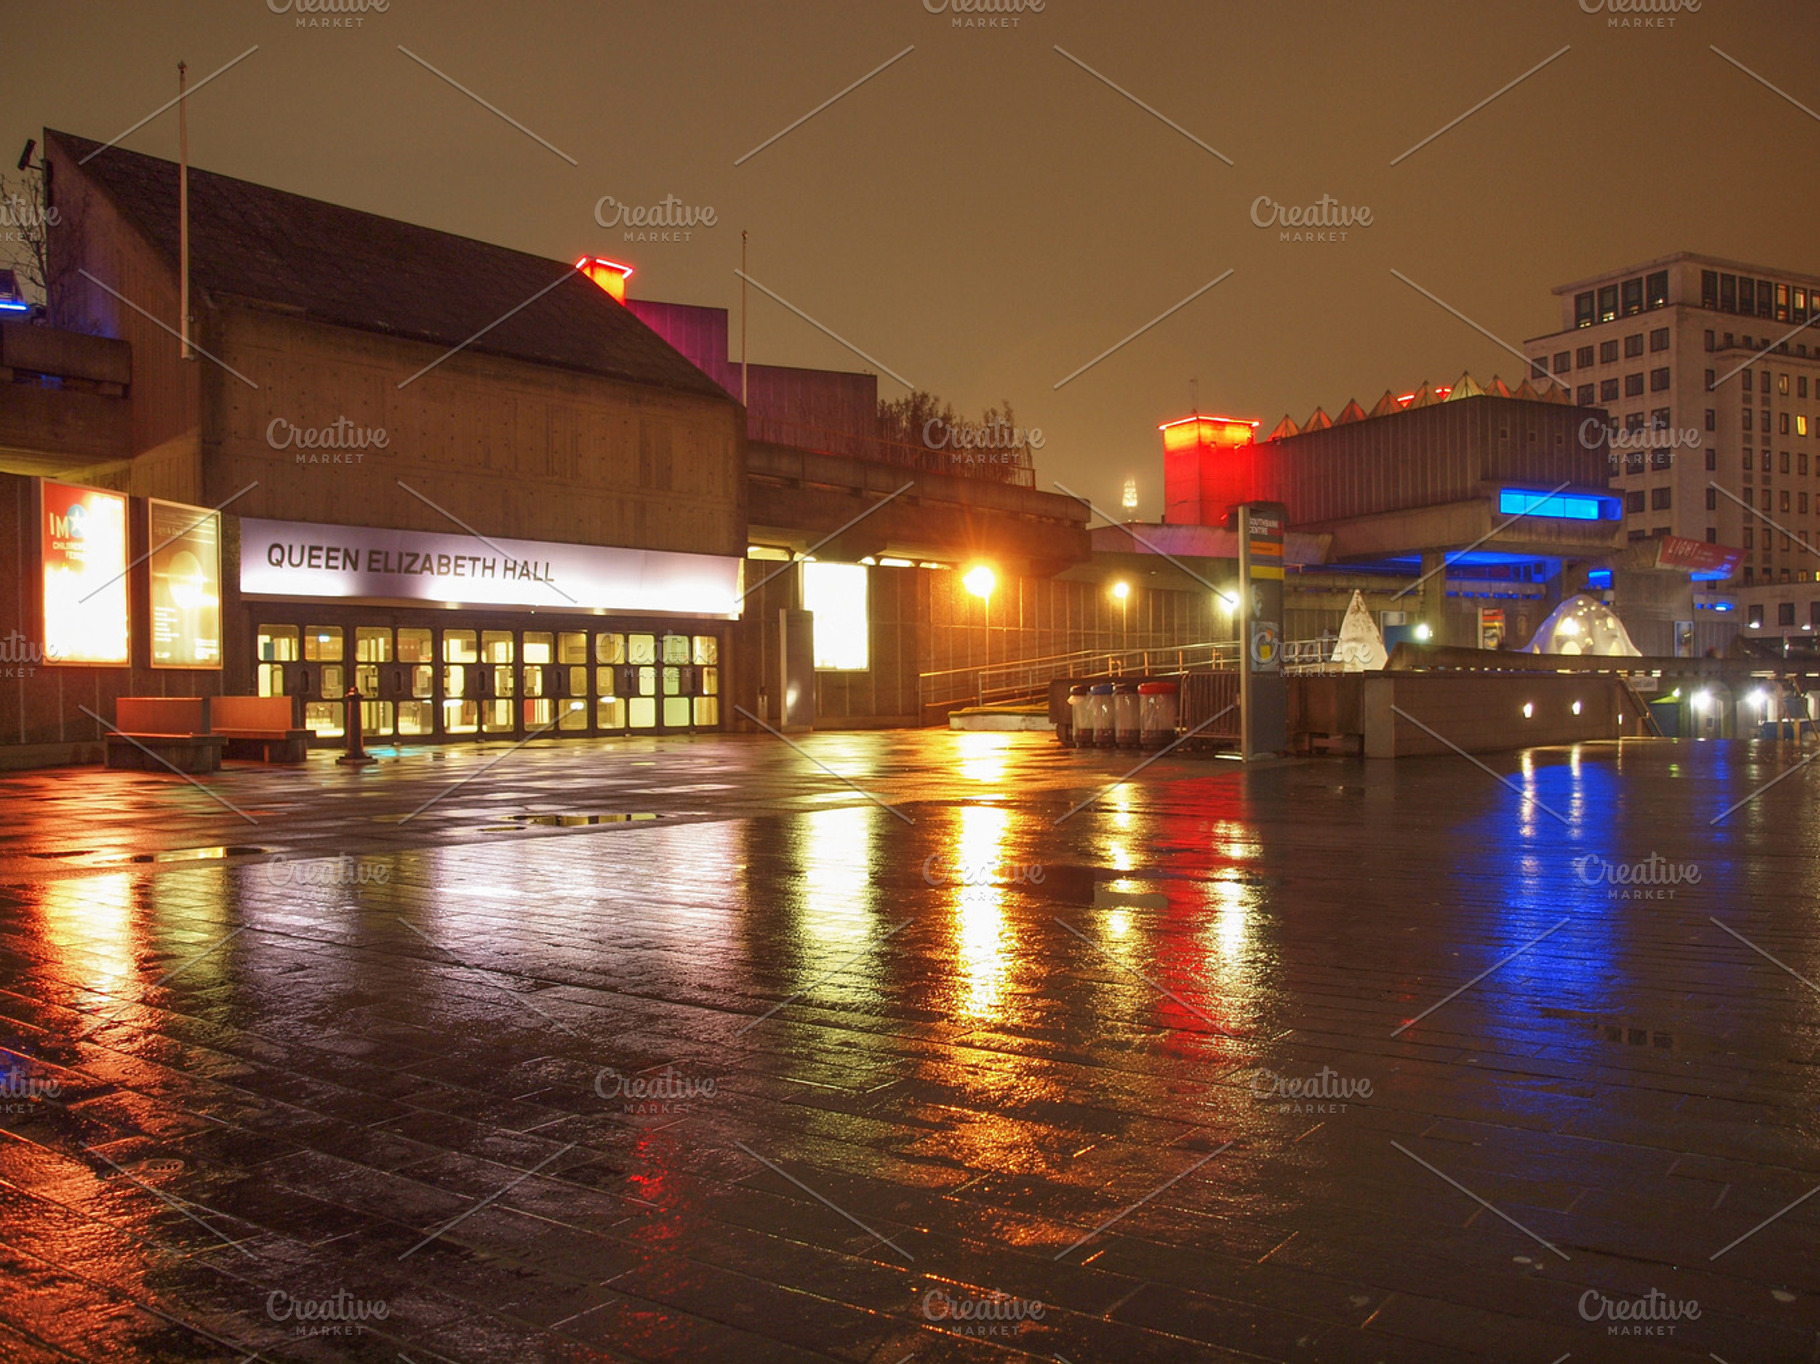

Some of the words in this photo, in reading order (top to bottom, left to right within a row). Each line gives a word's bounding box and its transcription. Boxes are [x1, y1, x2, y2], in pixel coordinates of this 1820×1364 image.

[267, 542, 359, 572] QUEEN
[366, 550, 496, 578] ELIZABETH
[503, 558, 555, 582] HALL
